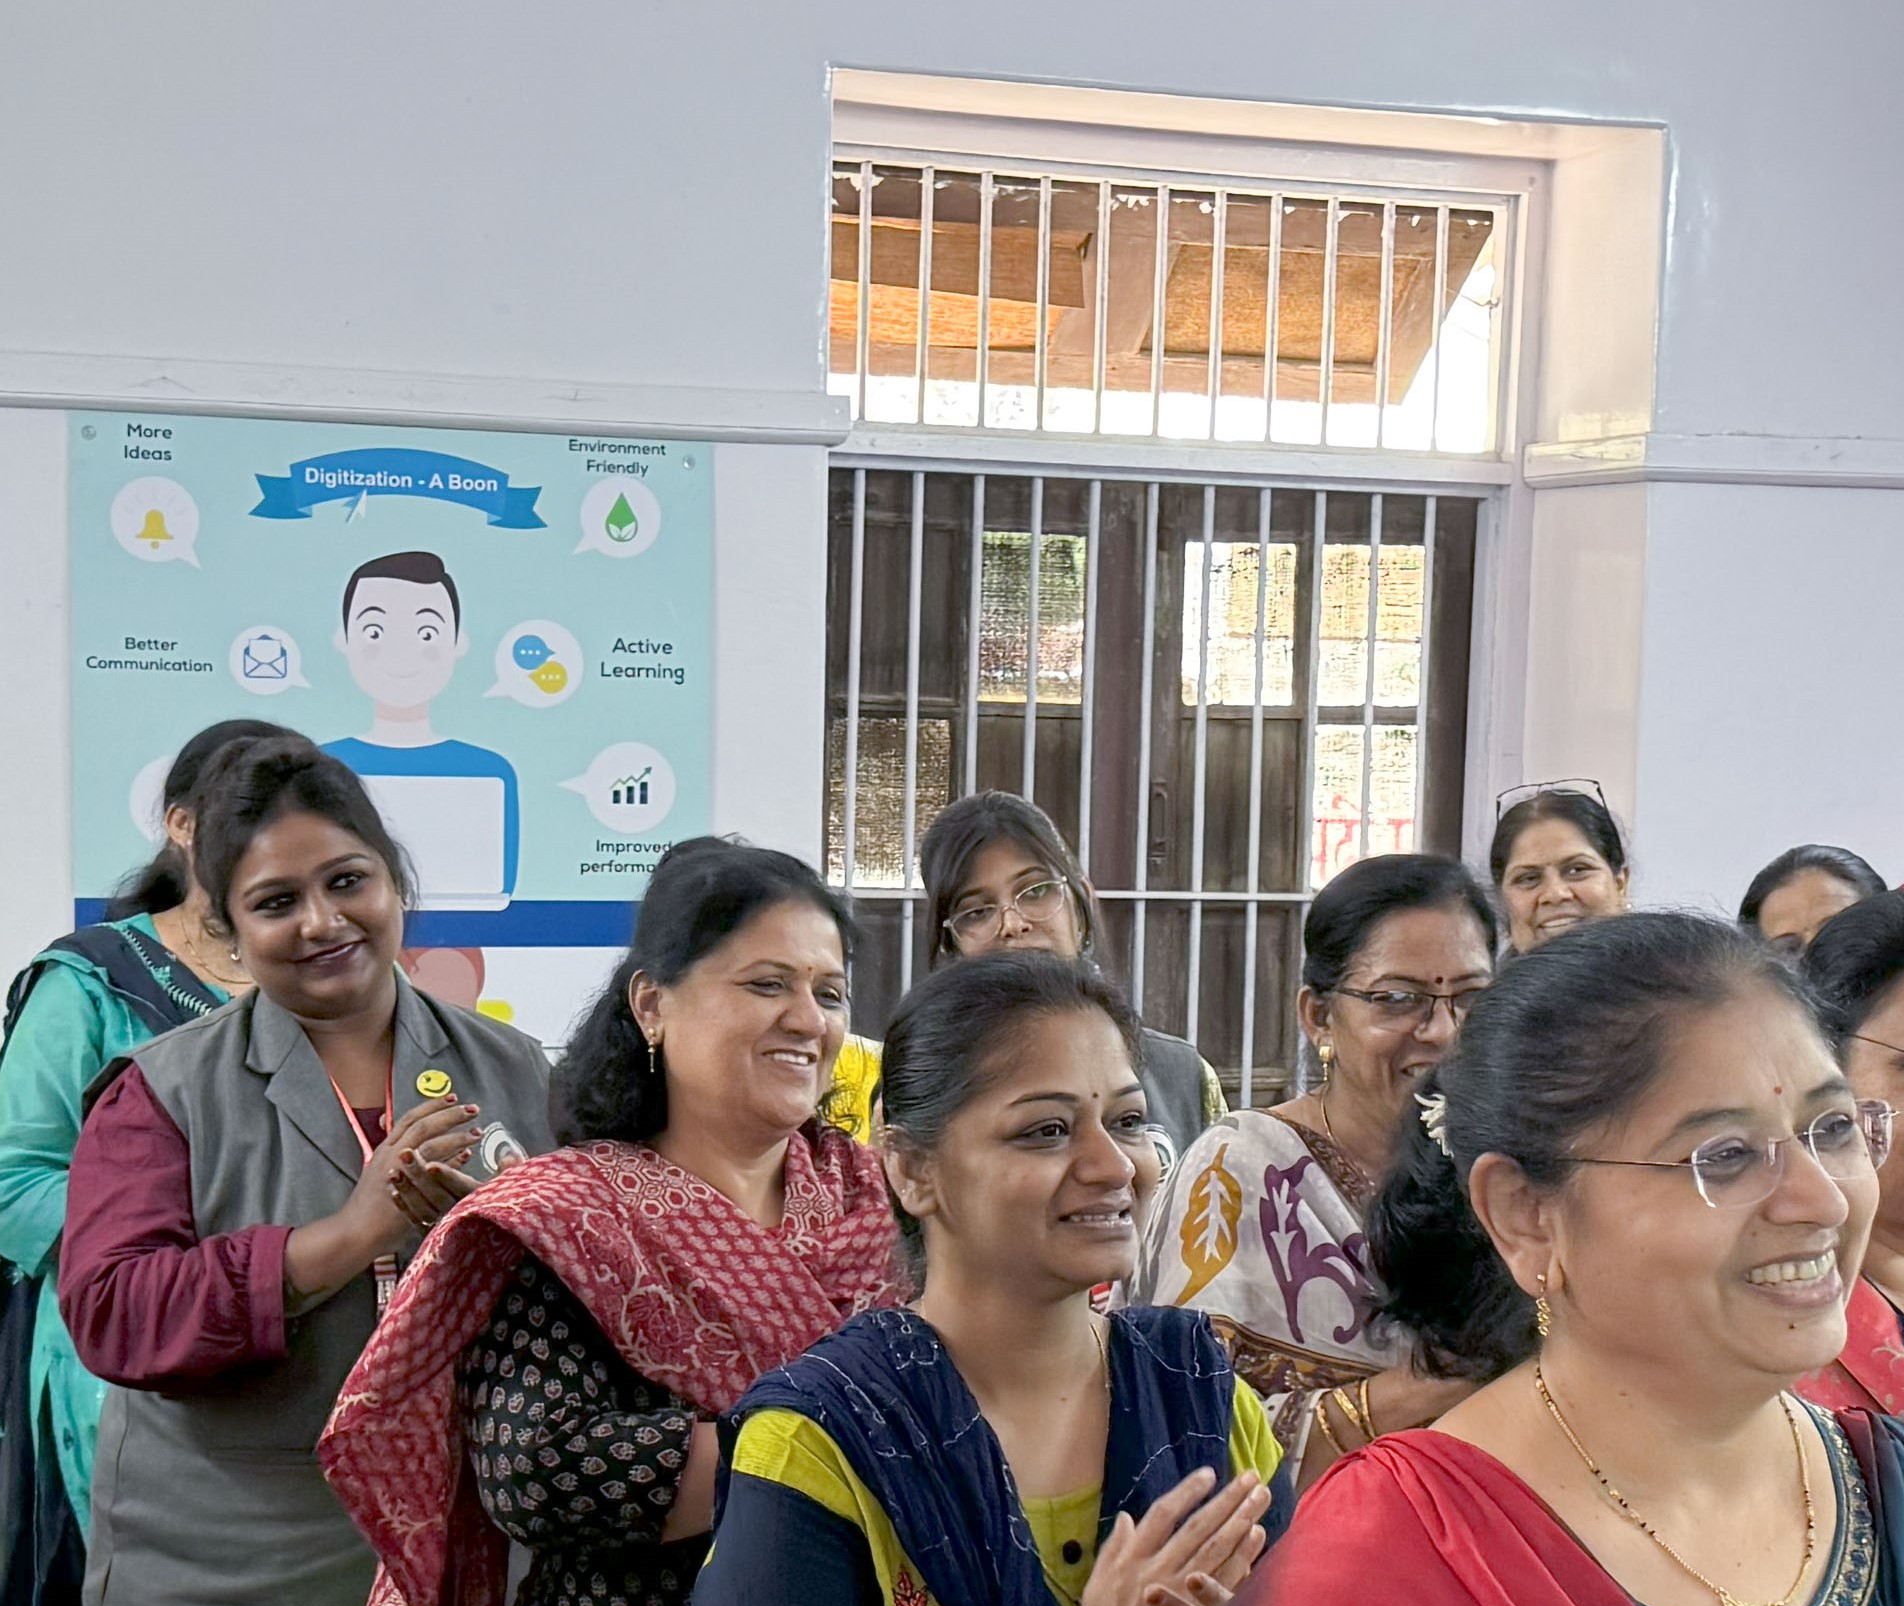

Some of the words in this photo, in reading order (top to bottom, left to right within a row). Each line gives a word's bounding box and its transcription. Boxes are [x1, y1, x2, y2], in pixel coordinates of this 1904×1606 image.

[127, 423, 173, 439] More
[124, 445, 172, 461] Ideas
[568, 439, 666, 456] Environment
[586, 459, 649, 477] Friendly
[305, 467, 412, 488] Digitization
[428, 473, 444, 489] A
[448, 474, 498, 491] Boon
[124, 637, 178, 651] Better
[612, 637, 673, 655] Active
[86, 656, 213, 672] Communication
[600, 661, 685, 685] Learning
[596, 839, 673, 856] Improved
[580, 860, 657, 875] performa
